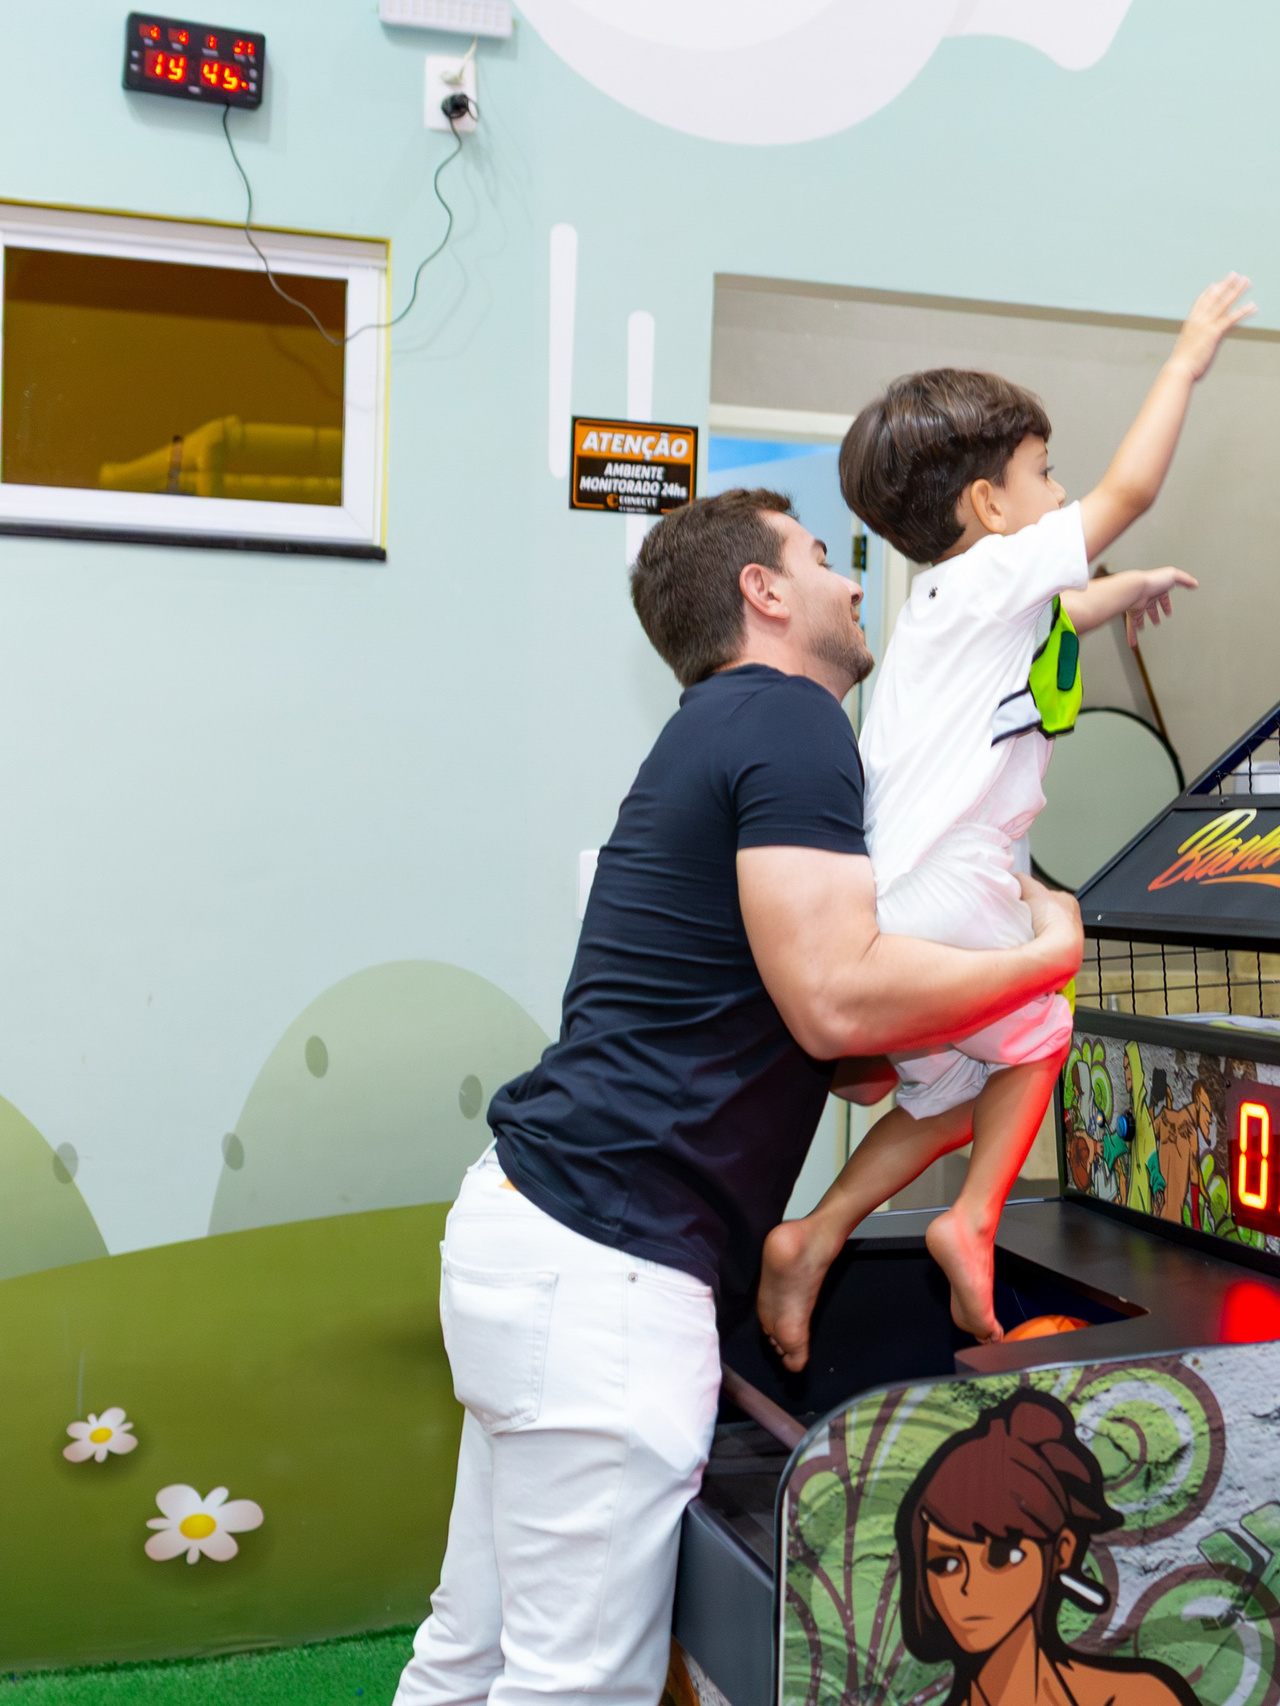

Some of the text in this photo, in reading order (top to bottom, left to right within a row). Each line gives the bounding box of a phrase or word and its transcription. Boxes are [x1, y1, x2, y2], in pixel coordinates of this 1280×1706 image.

[581, 431, 689, 462] ATENÇÃO
[603, 462, 665, 481] AMBIENTE
[579, 476, 688, 499] MONITORADO 24hs
